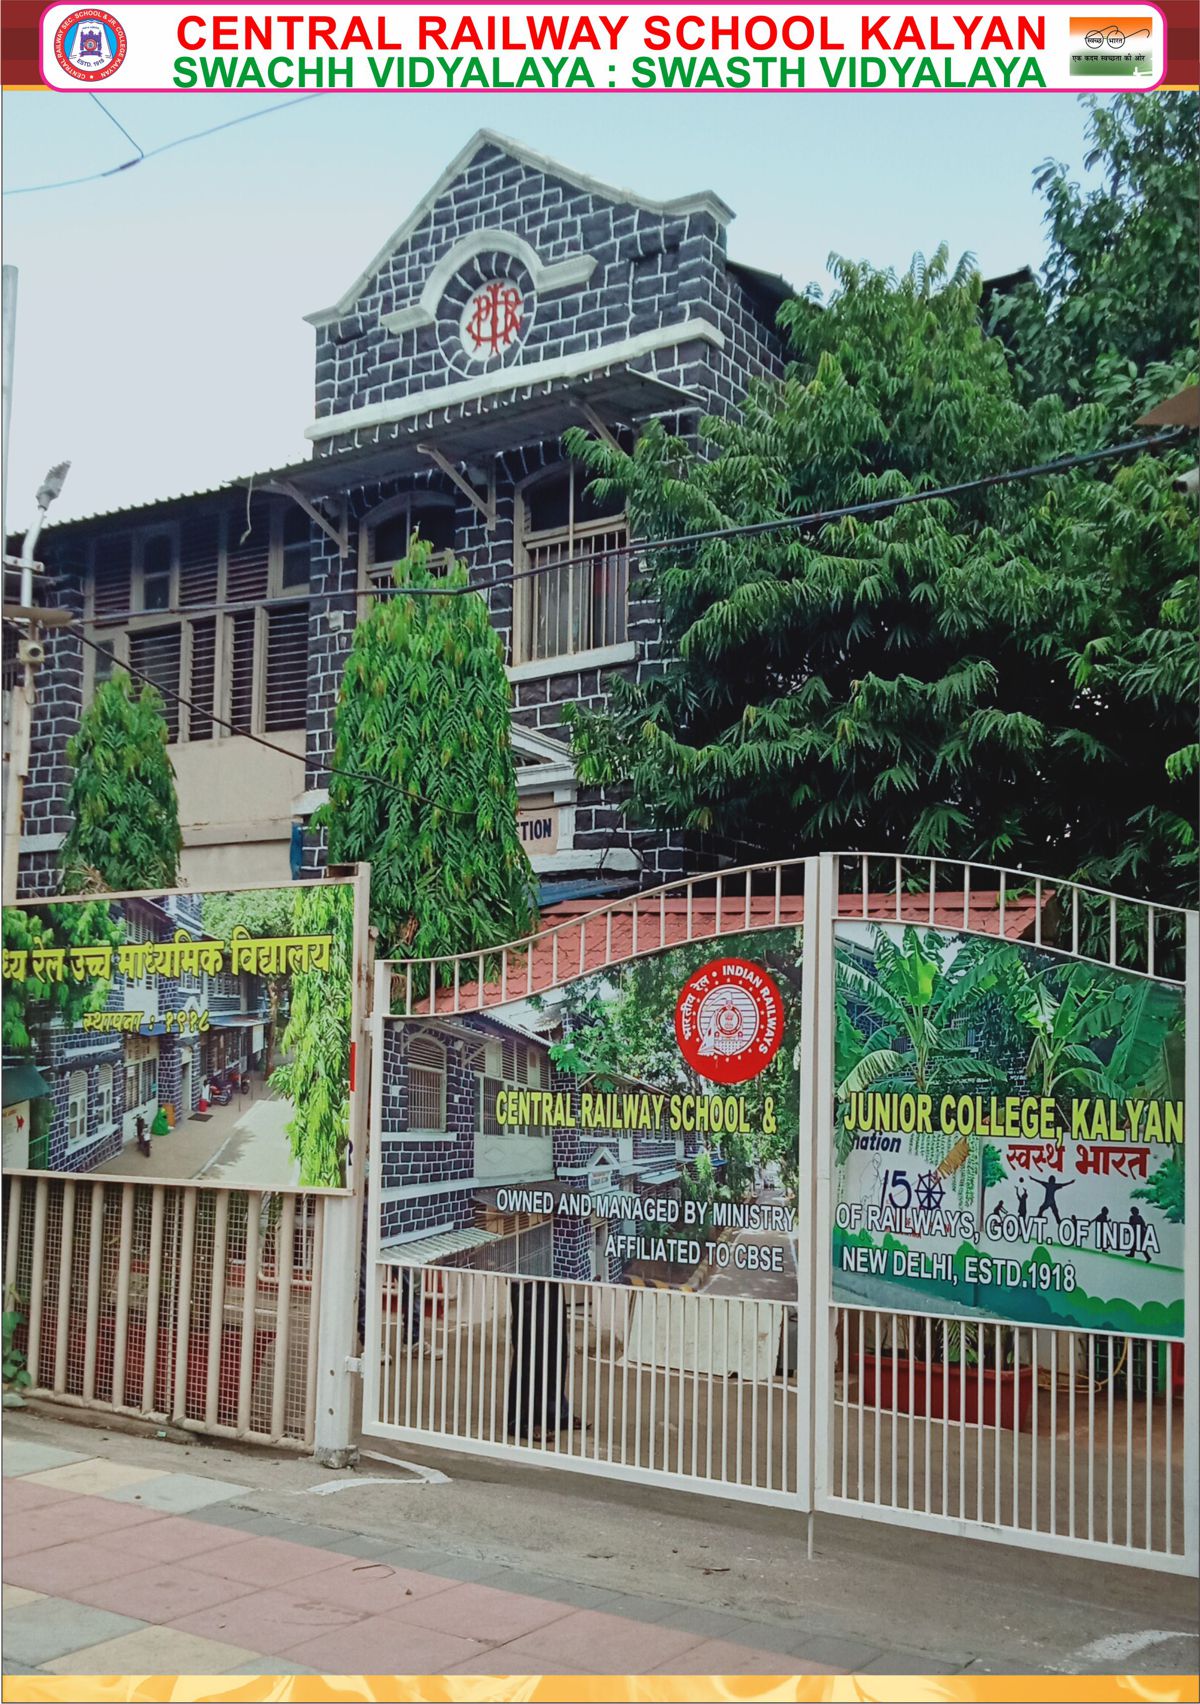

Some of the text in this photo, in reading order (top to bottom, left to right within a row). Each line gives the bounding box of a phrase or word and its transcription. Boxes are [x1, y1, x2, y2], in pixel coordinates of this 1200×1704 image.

[32, 936, 66, 983] रेल
[70, 946, 113, 981] उच्च
[116, 929, 225, 980] माध्यमिक
[231, 924, 333, 977] विद्यालय
[82, 1010, 145, 1033] स्थापना
[165, 1009, 210, 1034] १९१८
[680, 974, 711, 1041] भारतीय रेल
[722, 964, 777, 1055] INDIAN RAILWAYS
[495, 1091, 777, 1134] CENTRAL RAILWAY SCHOOL &
[844, 1092, 1184, 1149] JUNIOR COLLEGE, KALYAN
[1006, 1144, 1065, 1175] स्वस्थ
[1075, 1144, 1151, 1180] भारत
[496, 1188, 797, 1232] OWNED AND MANAGED BY MINISTRY
[836, 1202, 862, 1231] OF
[866, 1204, 980, 1243] RAILWAYS,
[985, 1213, 1052, 1246] GOVT.
[1058, 1219, 1091, 1248] OF
[1095, 1222, 1160, 1253] INDIA
[604, 1234, 784, 1272] AFFILIATED TO CBSE
[842, 1246, 1076, 1292] NEW DELHI, ESTD.1918
